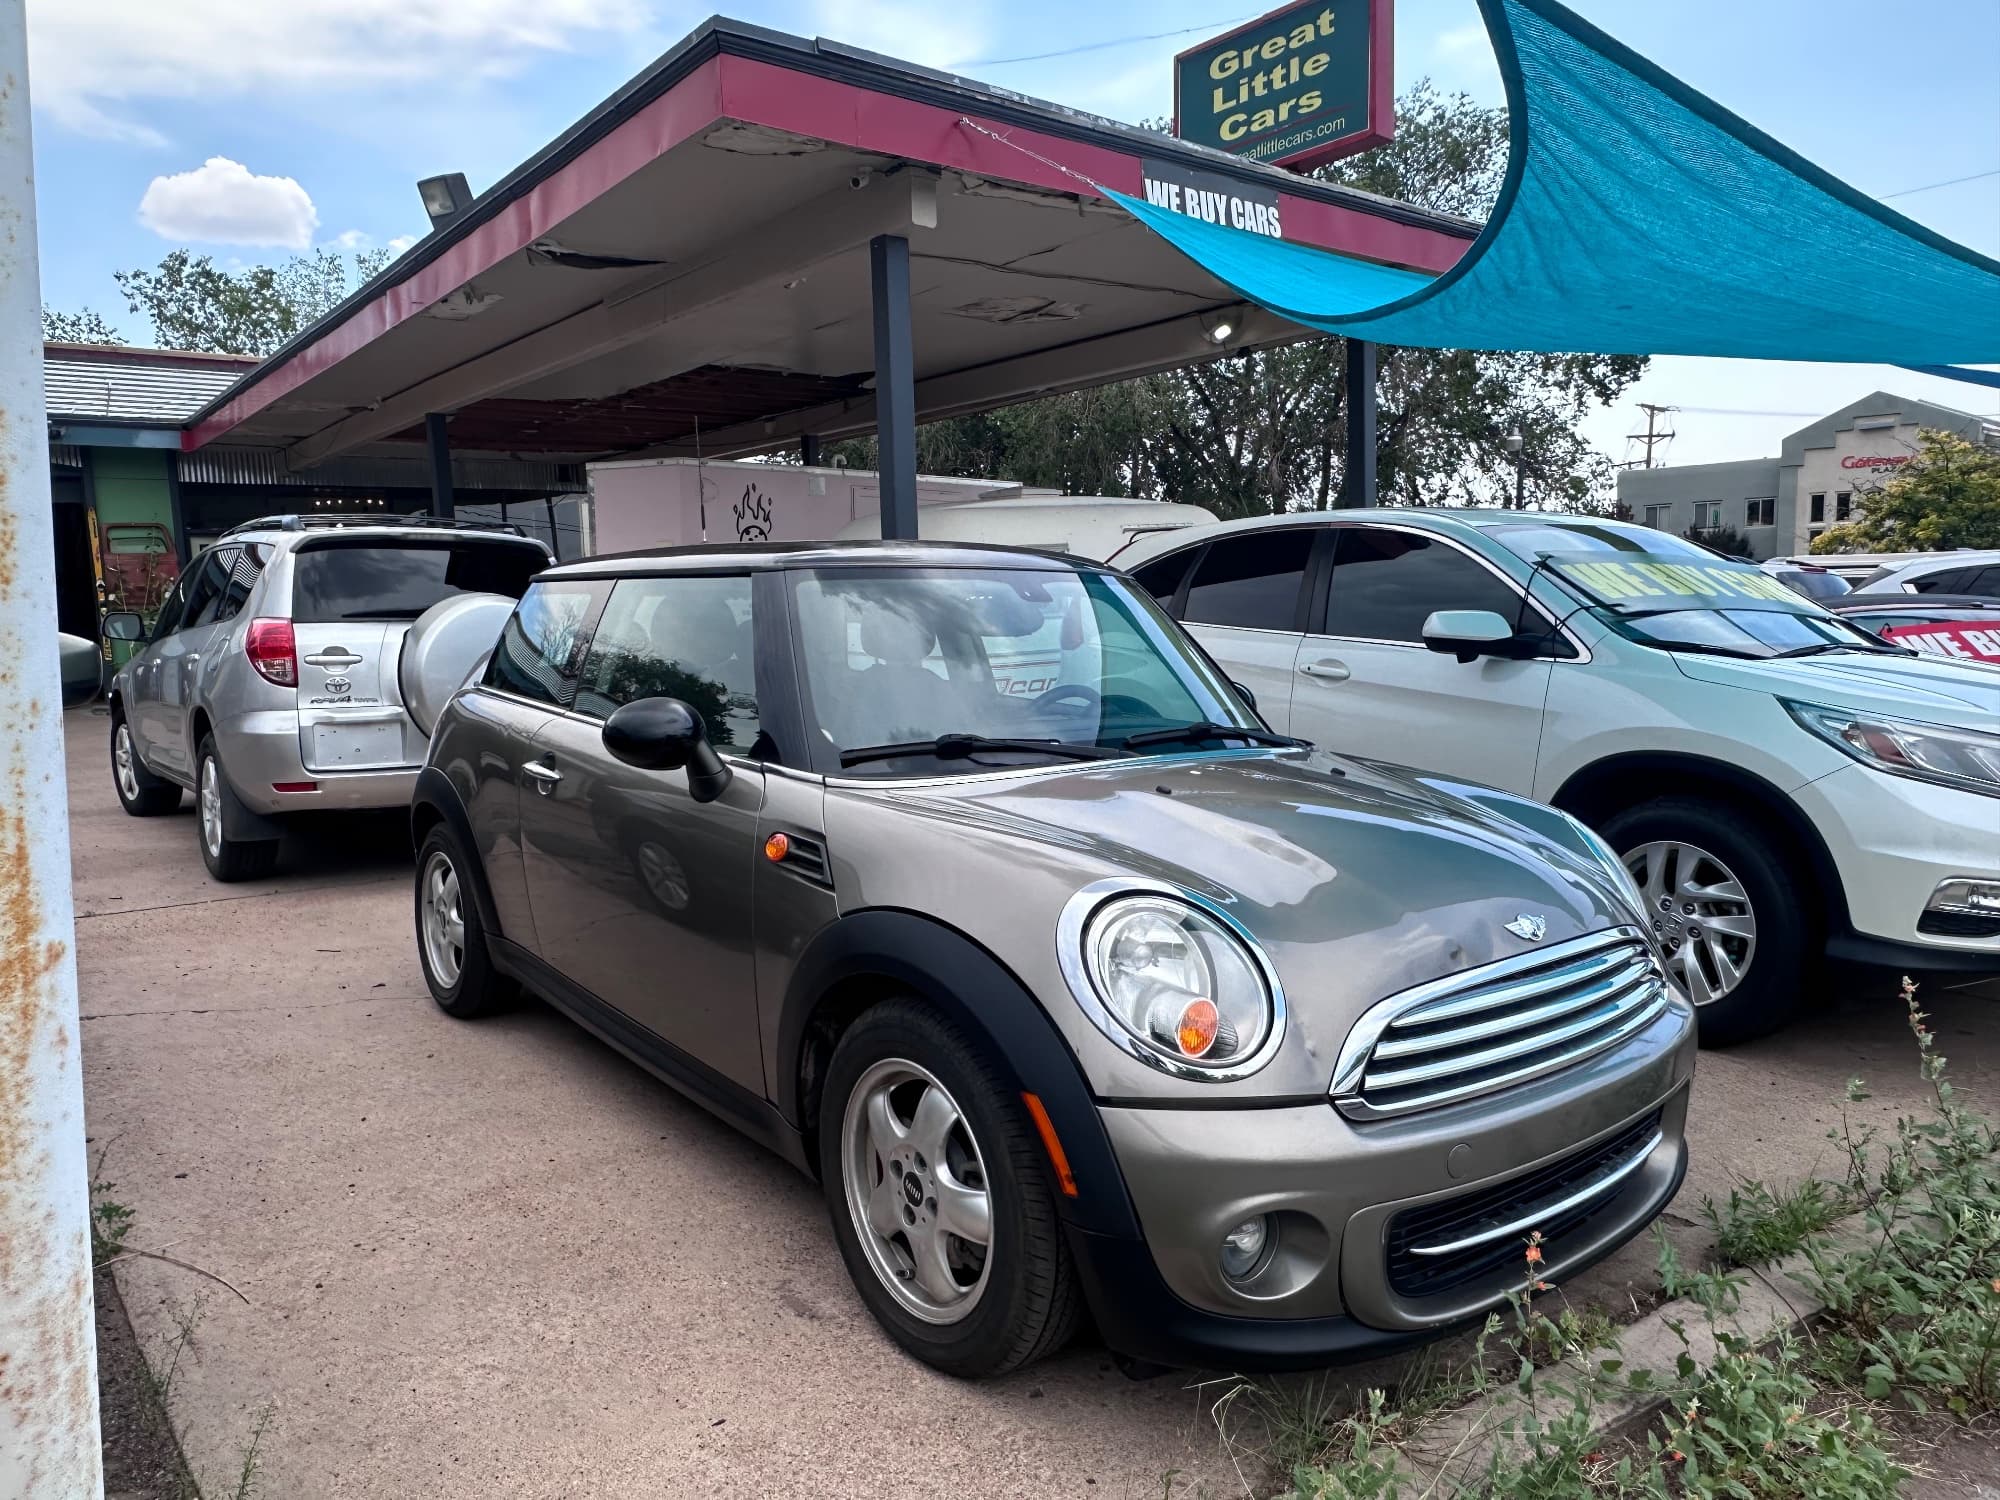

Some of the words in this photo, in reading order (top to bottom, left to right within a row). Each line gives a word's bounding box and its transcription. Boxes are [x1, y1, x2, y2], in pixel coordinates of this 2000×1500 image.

[1209, 8, 1335, 80] Great
[1213, 53, 1331, 113] Little
[1219, 90, 1322, 141] Cars
[1238, 117, 1345, 161] eatlittlecars.com
[1144, 178, 1182, 214] WE
[1184, 186, 1227, 226] BUY
[1230, 197, 1282, 239] CARS
[1560, 562, 1667, 598] WE
[1628, 561, 1736, 597] BUY
[1892, 631, 1975, 657] WE
